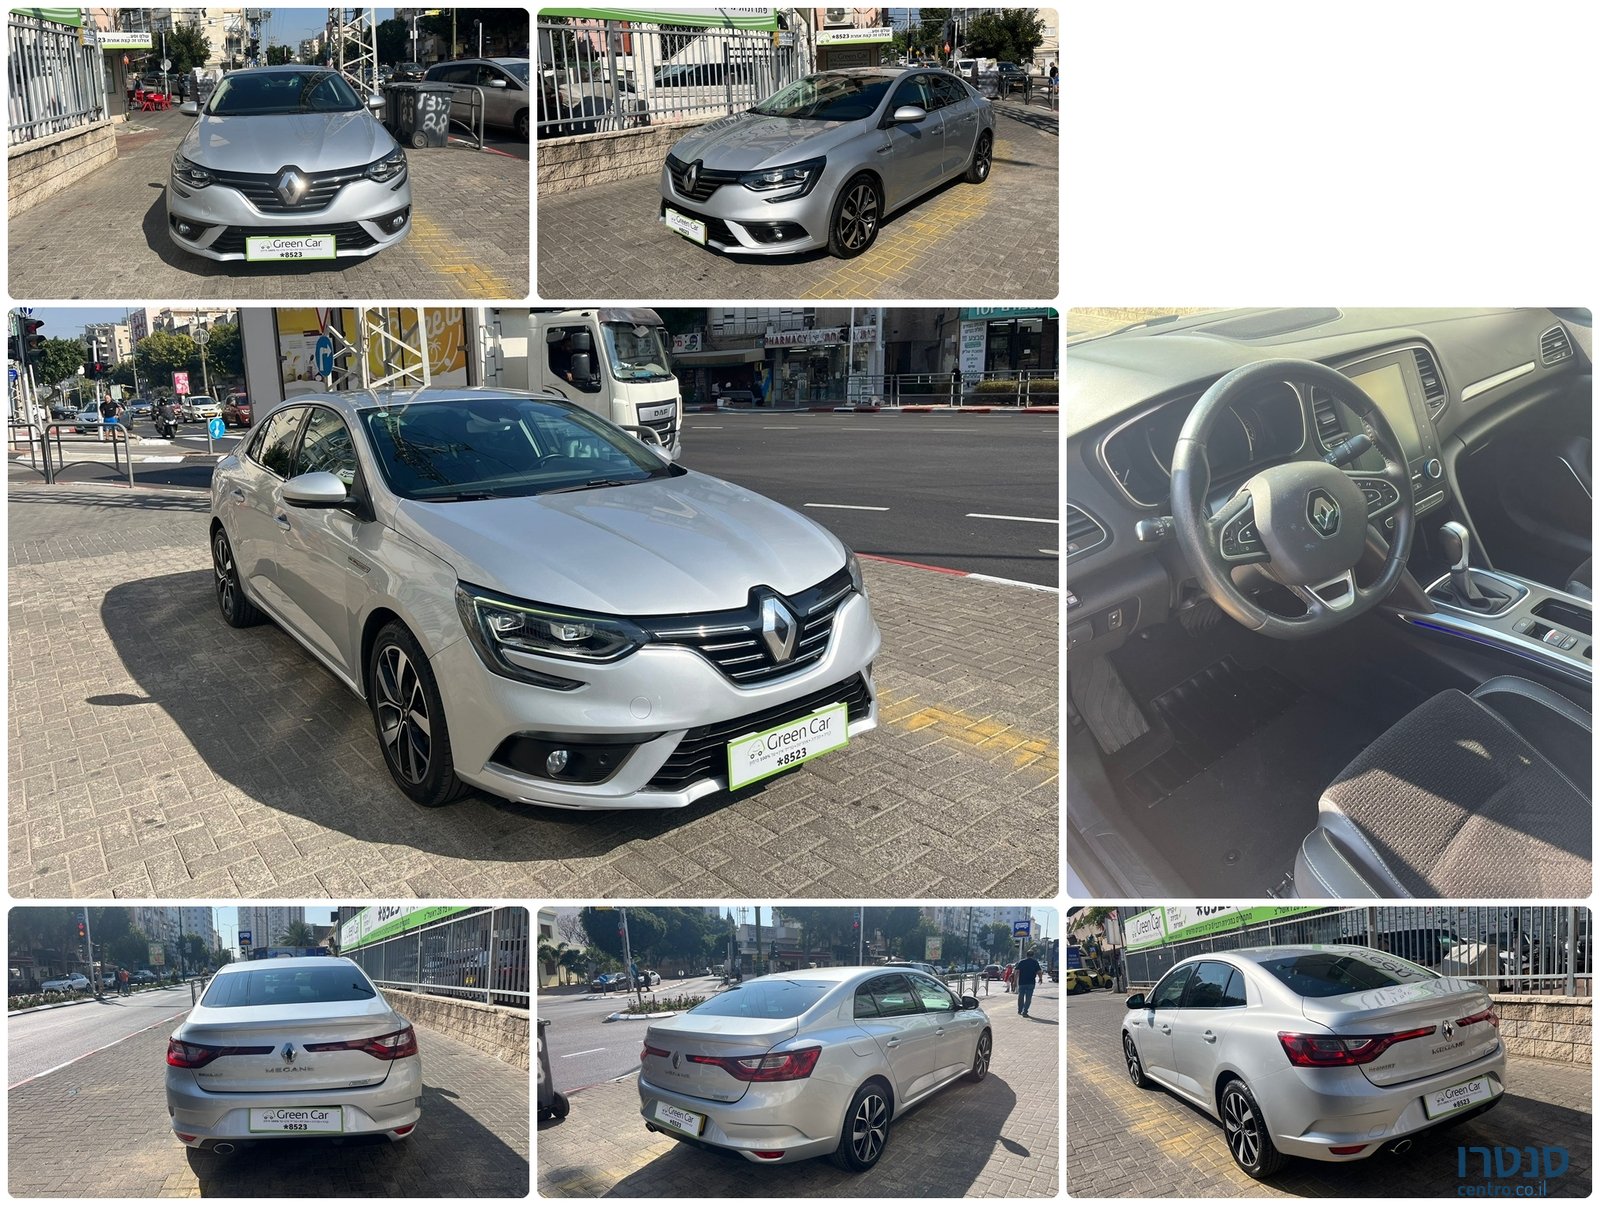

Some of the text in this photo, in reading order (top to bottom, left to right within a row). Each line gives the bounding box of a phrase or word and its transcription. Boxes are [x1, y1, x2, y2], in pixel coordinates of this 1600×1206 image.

[422, 112, 448, 134] 28
[676, 216, 690, 227] Green
[690, 222, 699, 230] Car
[273, 238, 322, 248] Green Car
[766, 334, 808, 345] PHARMACY
[767, 726, 807, 750] Green
[809, 717, 831, 735] Car
[1136, 914, 1160, 935] Green Car
[1445, 1085, 1468, 1100] Green
[1468, 1082, 1481, 1094] Car
[276, 1108, 328, 1120] Green Car
[668, 1106, 694, 1124] Green Car
